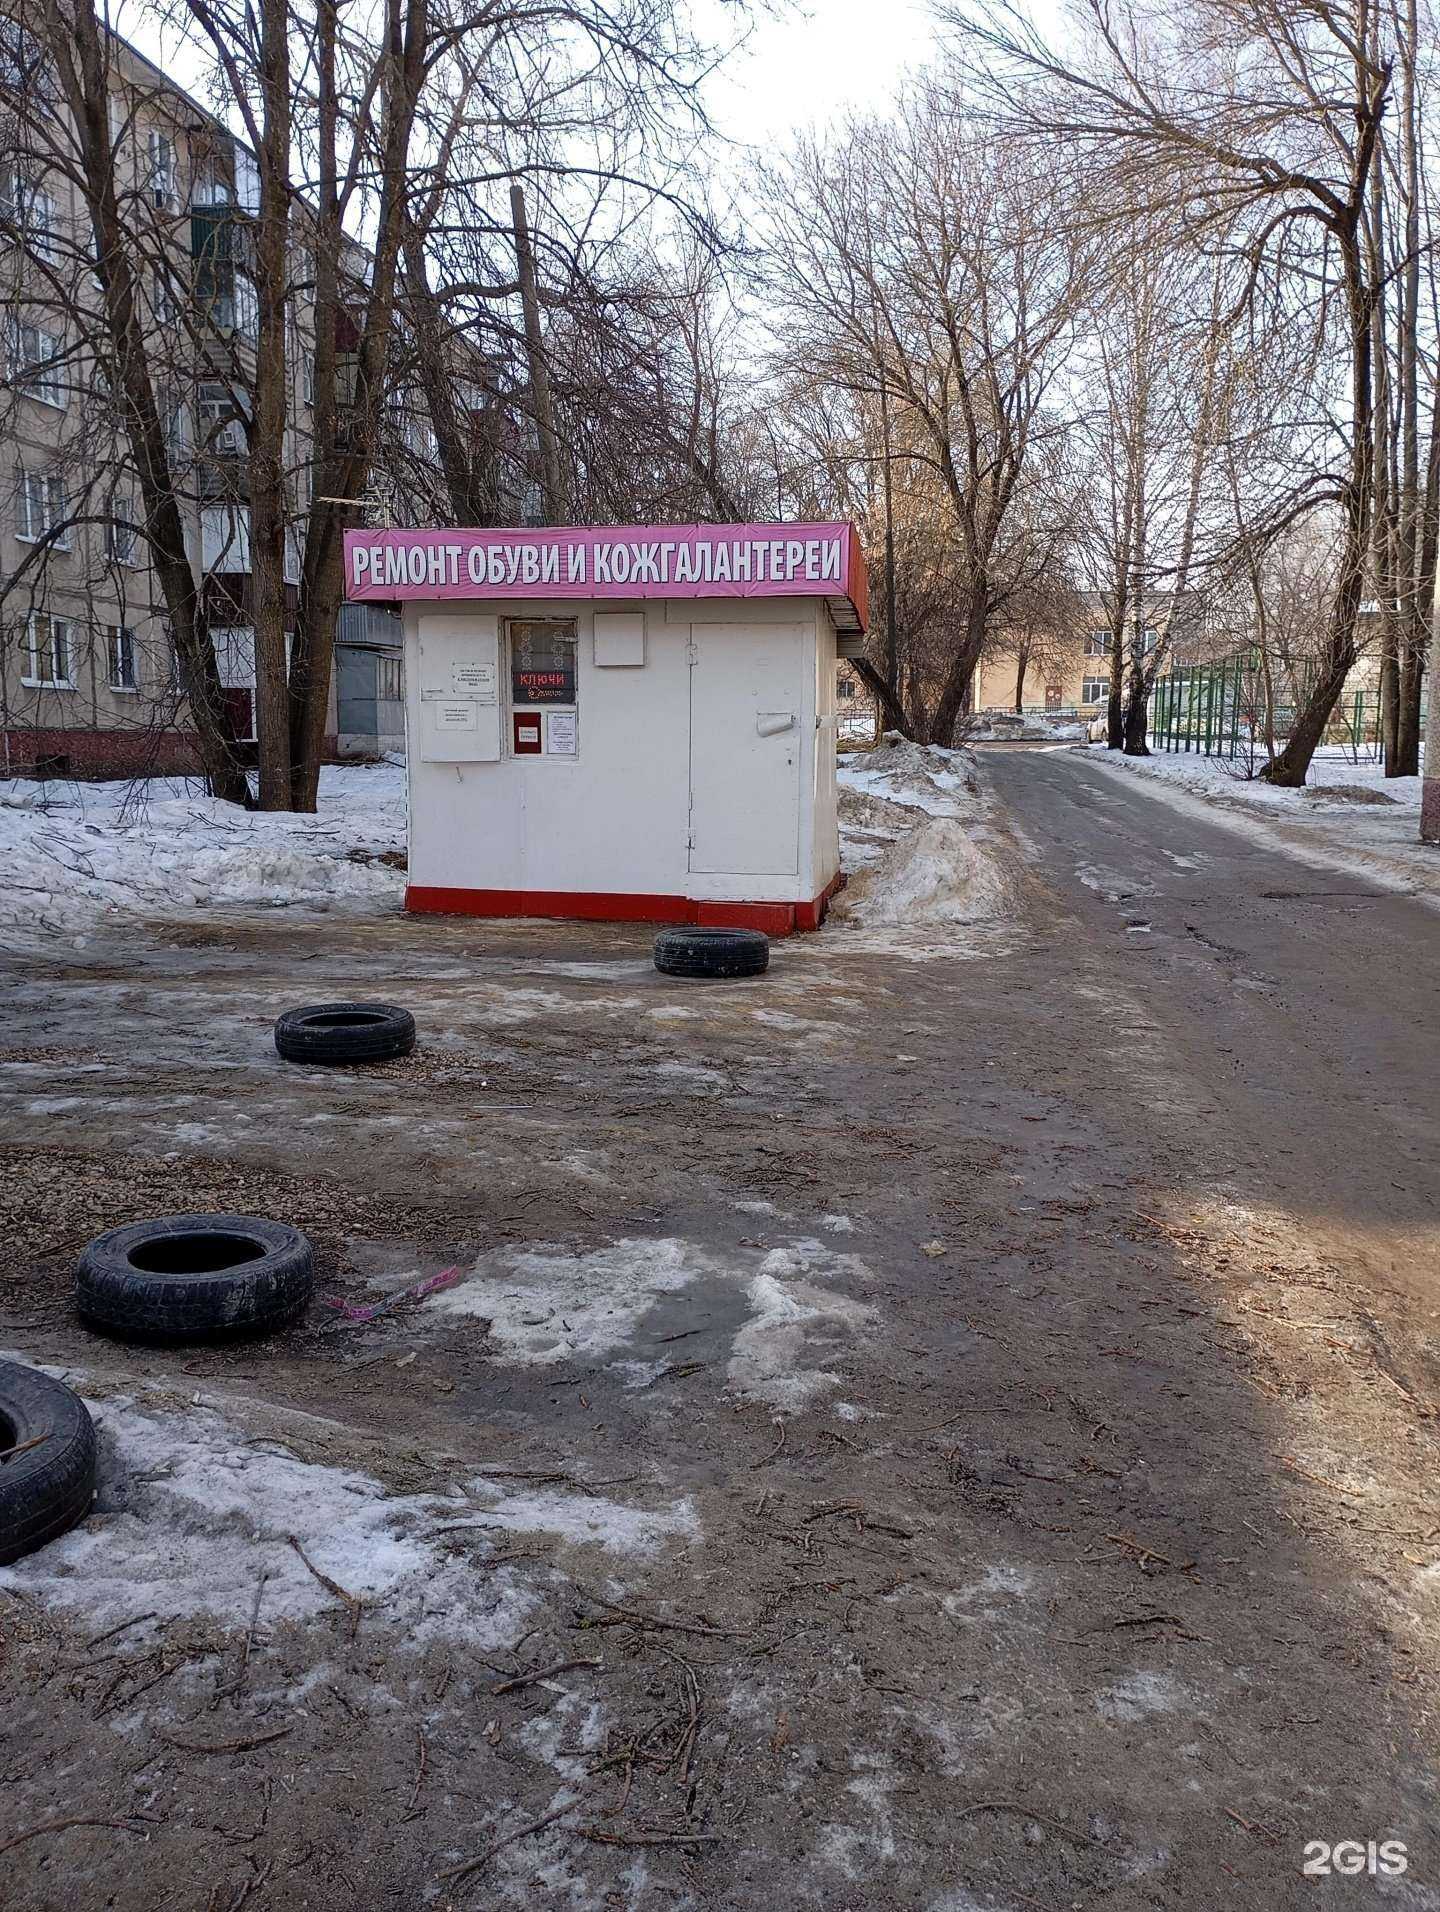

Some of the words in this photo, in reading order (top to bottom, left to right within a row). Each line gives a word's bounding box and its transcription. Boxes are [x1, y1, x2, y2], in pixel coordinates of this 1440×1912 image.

[352, 545, 462, 585] РЕМОНТ
[467, 544, 560, 584] ОБУВИ
[567, 544, 586, 583] И
[593, 539, 841, 583] КОЖГАЛАНТЕРЕИ
[519, 673, 565, 686] КЛЮЧИ
